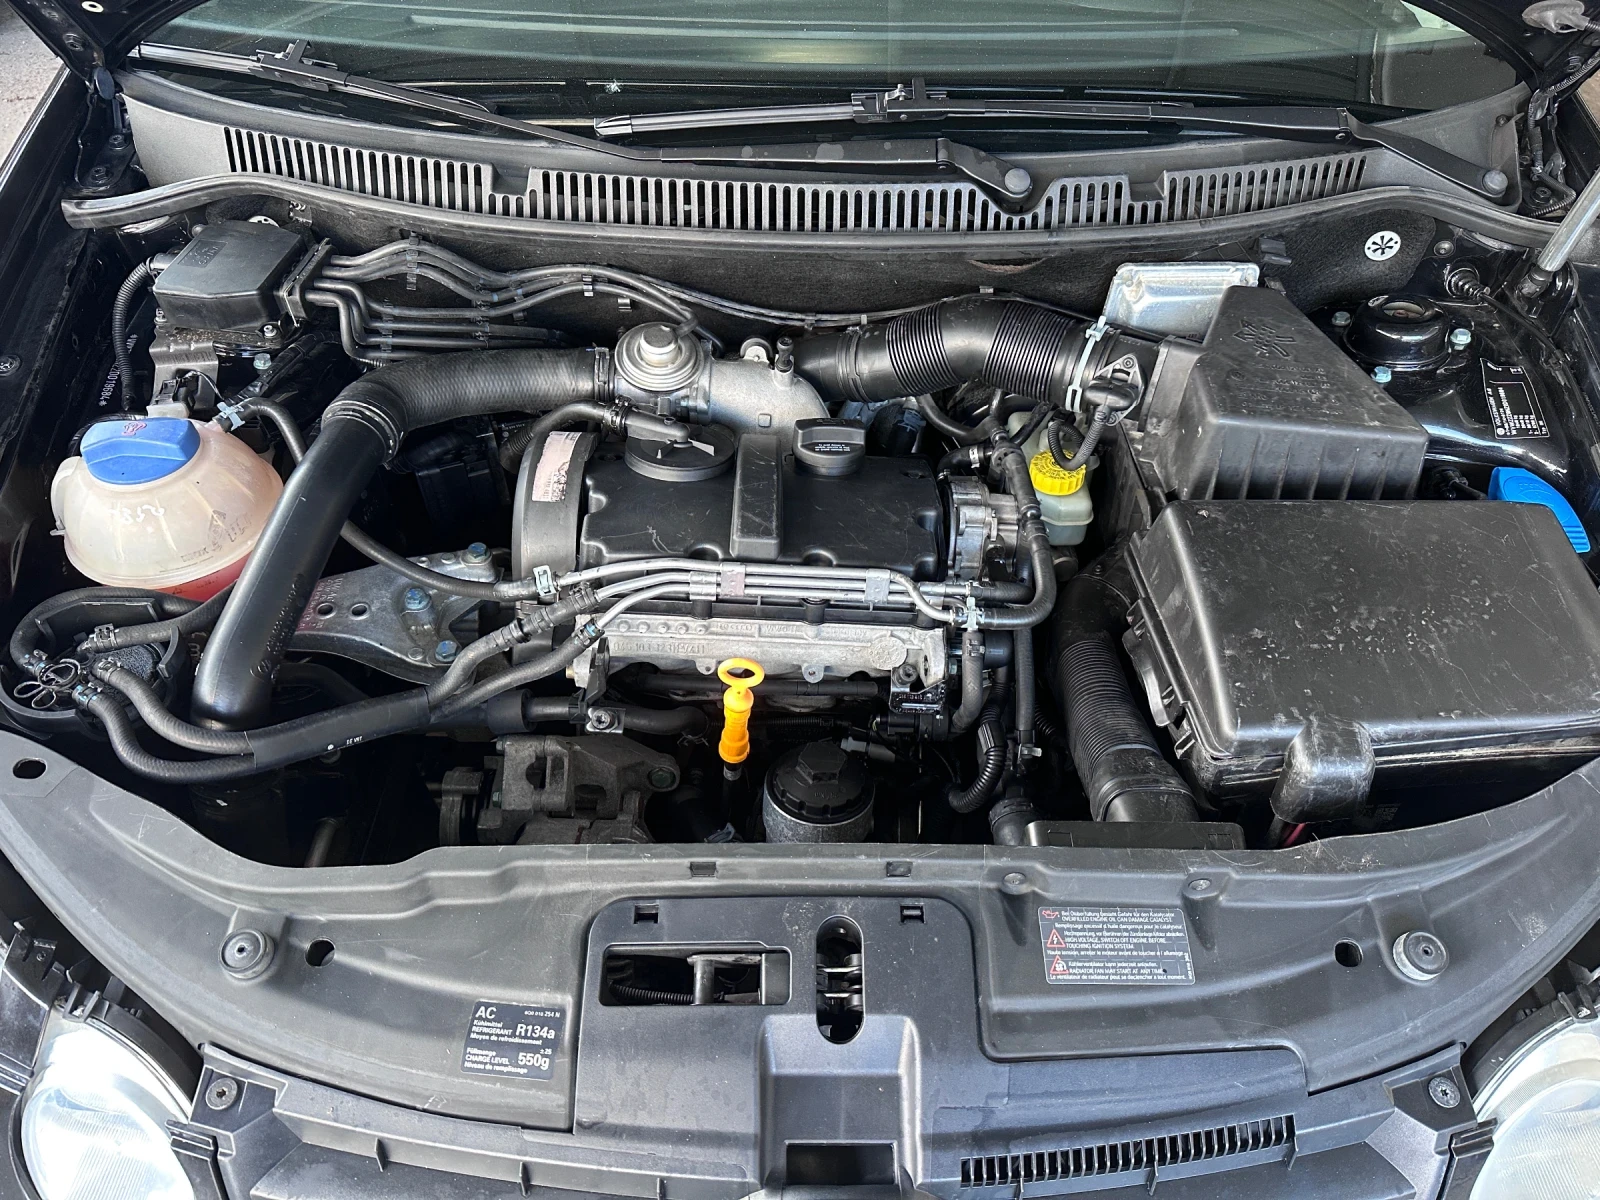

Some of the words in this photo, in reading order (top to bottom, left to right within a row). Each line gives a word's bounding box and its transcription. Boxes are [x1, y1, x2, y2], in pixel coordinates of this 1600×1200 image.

[475, 1006, 496, 1019] AC
[472, 1026, 512, 1035] REFRIGERANT
[516, 1024, 555, 1039] R134a
[518, 1052, 549, 1070] 550g
